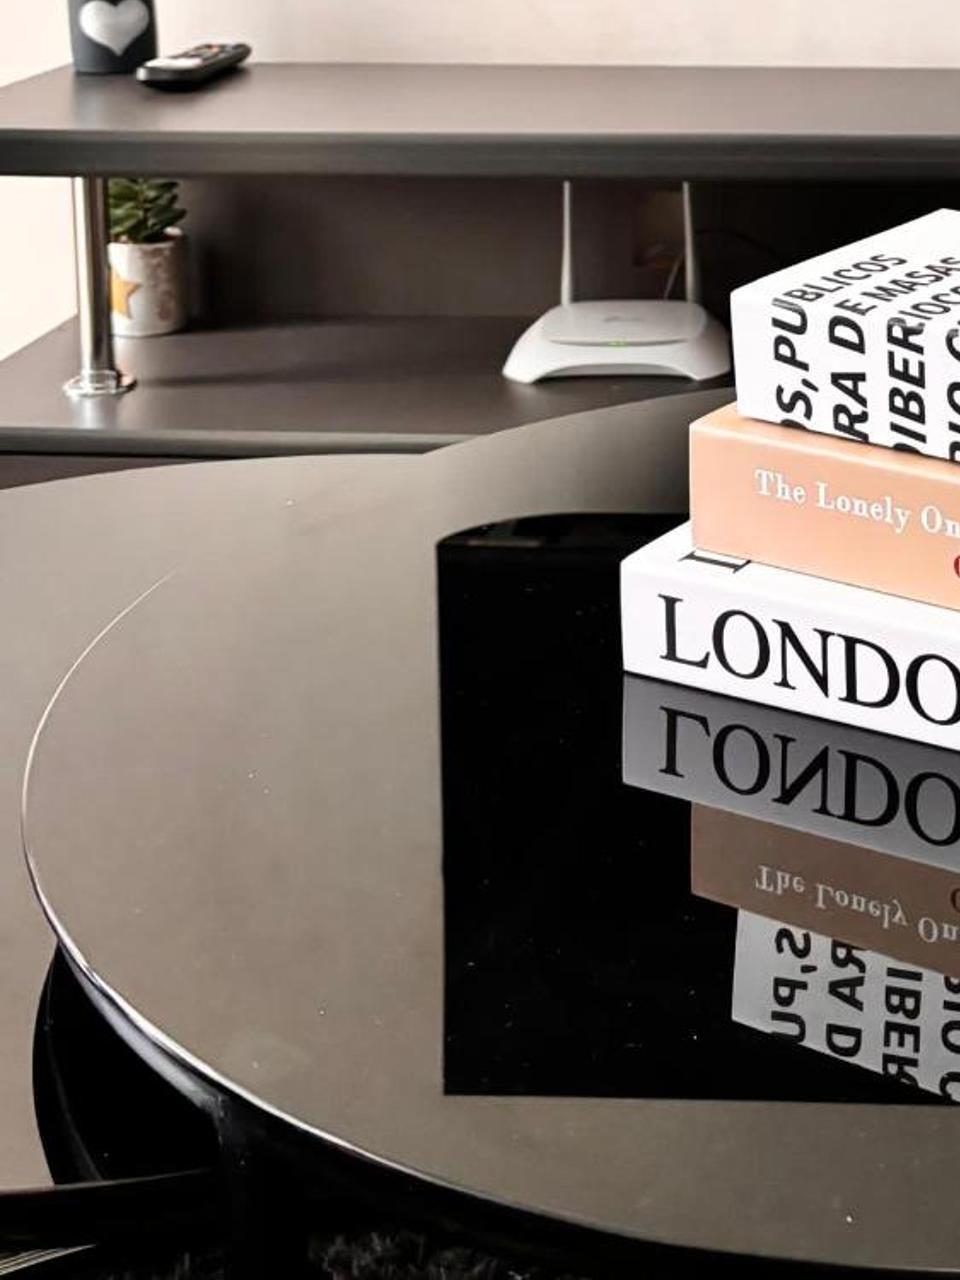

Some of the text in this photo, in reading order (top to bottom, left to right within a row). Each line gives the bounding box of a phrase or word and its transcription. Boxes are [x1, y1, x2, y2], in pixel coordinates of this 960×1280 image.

[772, 254, 907, 430] S,PUBLICOS
[828, 298, 878, 355] DE
[755, 469, 806, 505] The
[815, 481, 910, 533] Lonely
